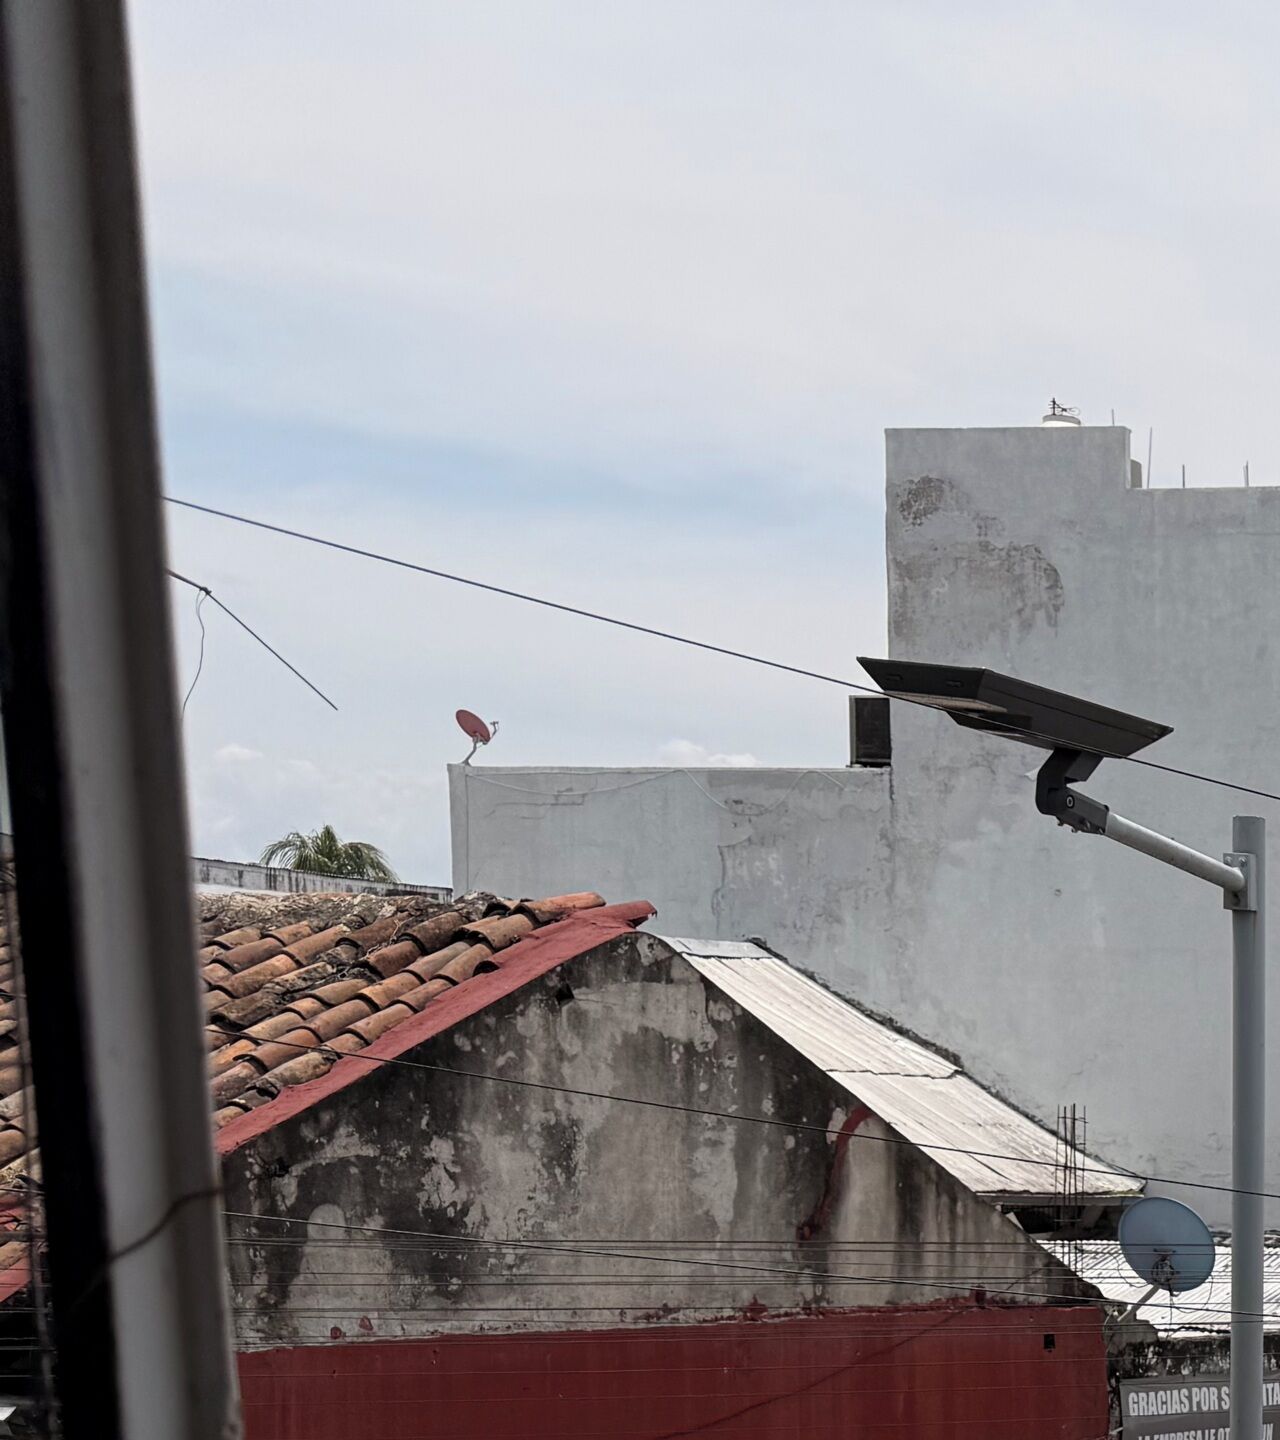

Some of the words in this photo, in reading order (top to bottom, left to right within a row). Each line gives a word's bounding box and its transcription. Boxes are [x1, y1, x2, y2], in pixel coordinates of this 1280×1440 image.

[1128, 1388, 1189, 1416] GRACIAS
[1192, 1386, 1219, 1412] POR
[1221, 1385, 1230, 1410] S
[1262, 1382, 1280, 1406] ITA
